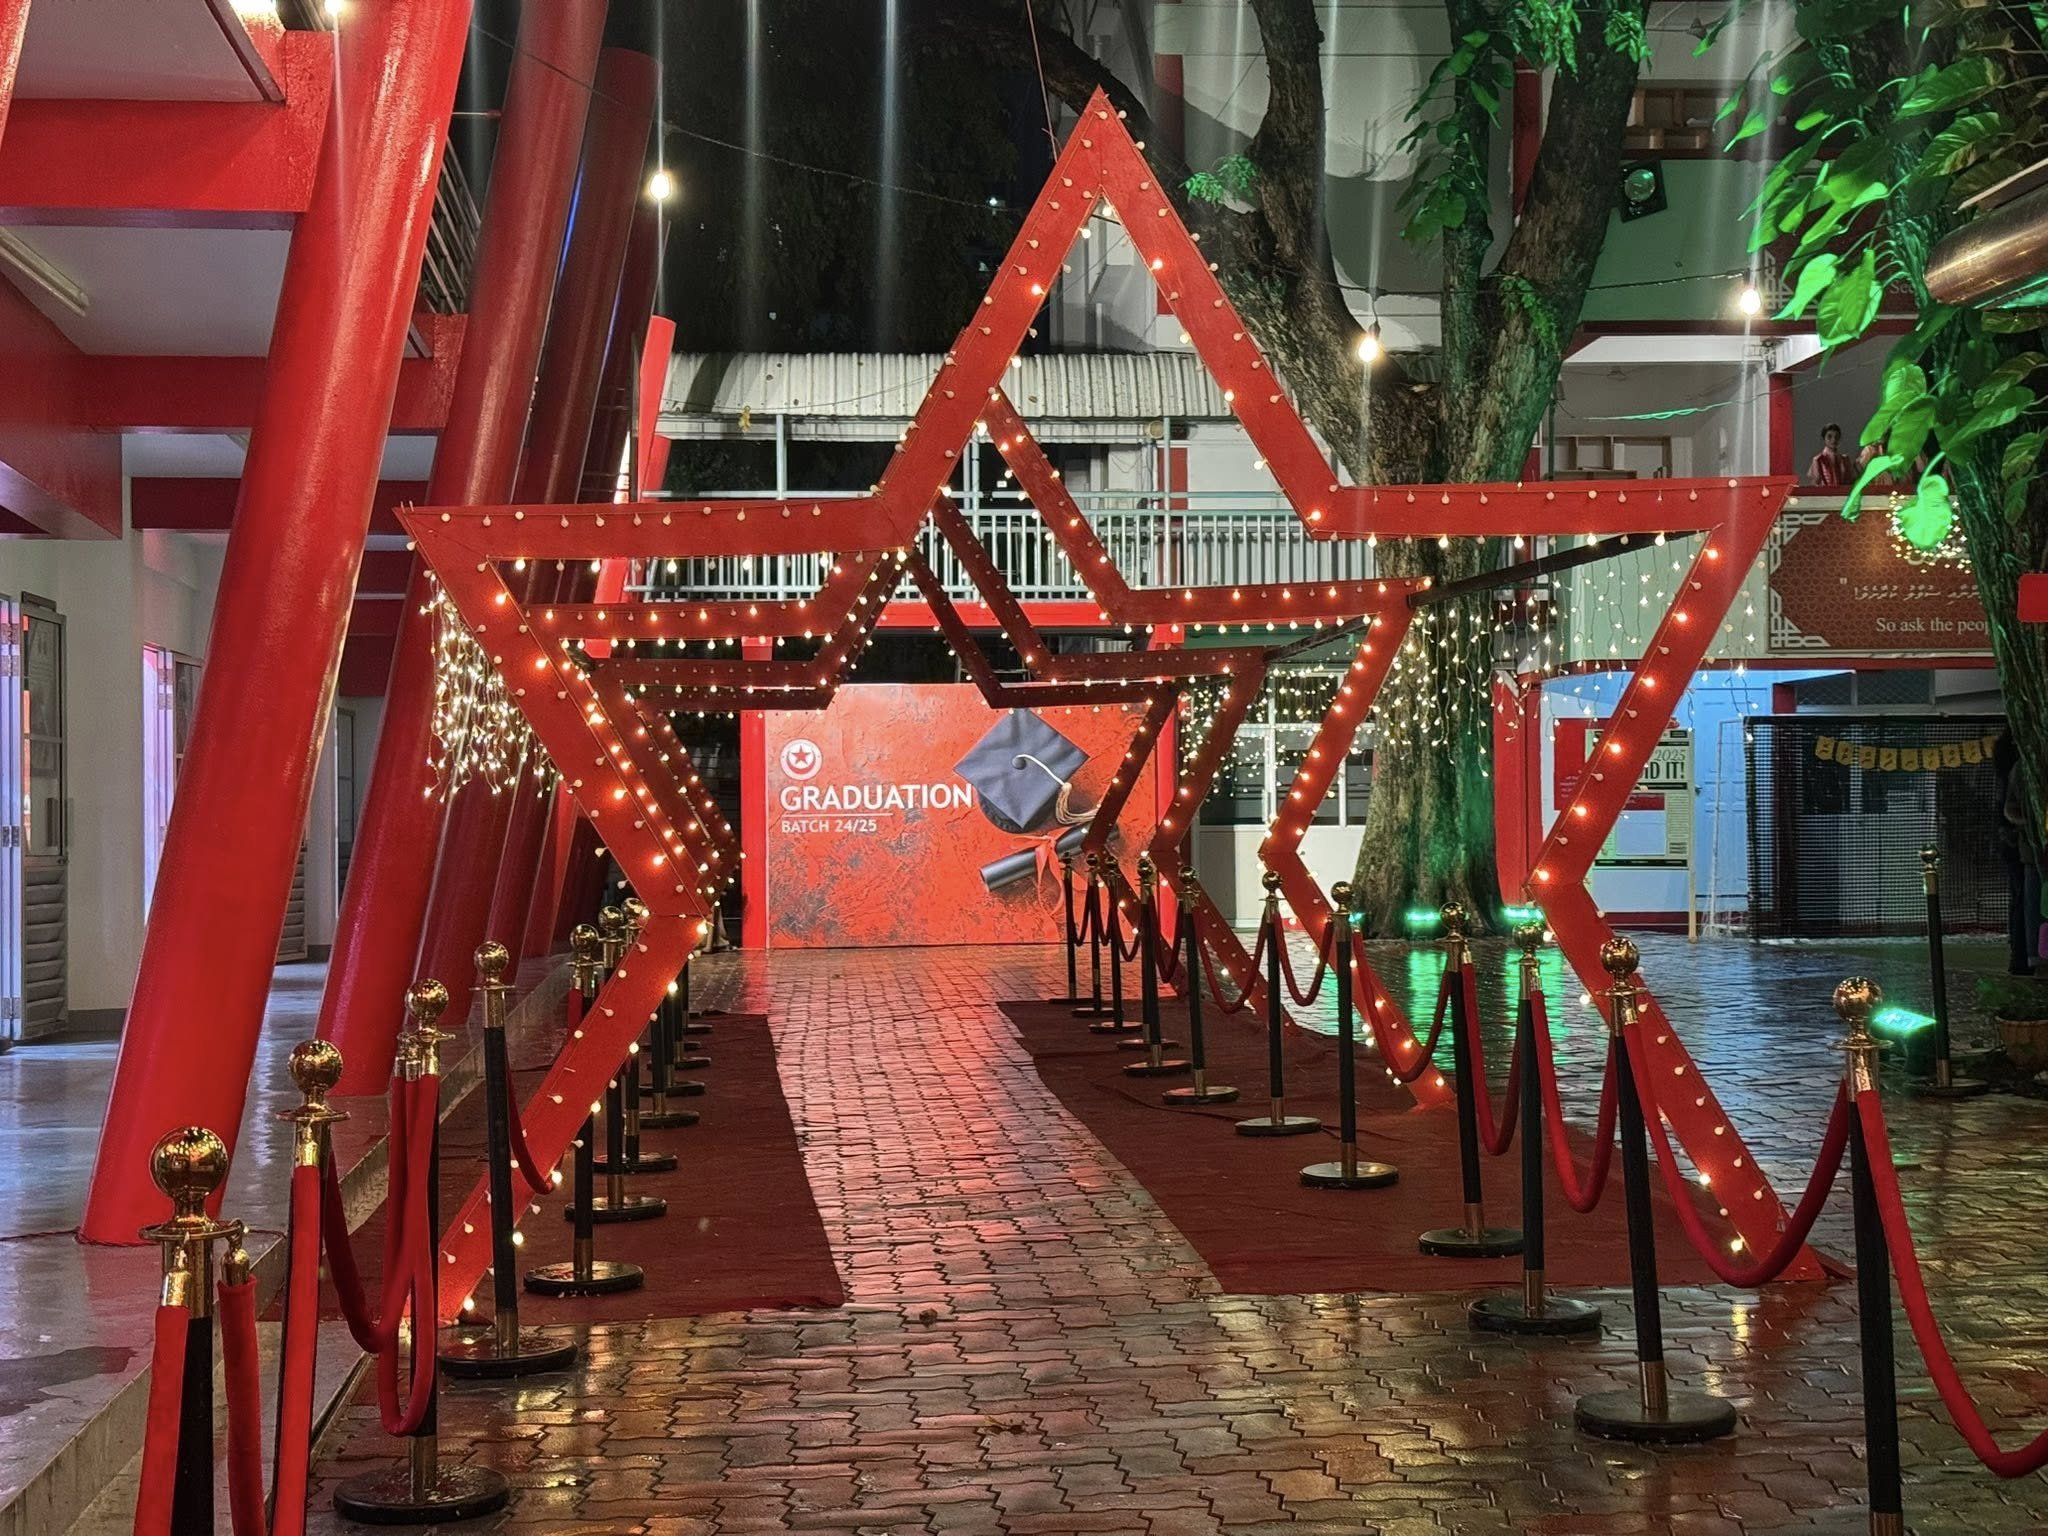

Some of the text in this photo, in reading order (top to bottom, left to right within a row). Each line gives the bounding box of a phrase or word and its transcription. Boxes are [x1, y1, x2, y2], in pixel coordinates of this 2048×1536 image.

[1876, 617, 1898, 632] So
[1900, 617, 1926, 632] ask
[1930, 617, 1953, 632] the
[1653, 749, 1687, 762] 2025
[1640, 761, 1685, 779] ID IT!
[779, 782, 973, 812] GRADUATION
[780, 818, 878, 834] BATCH 24/25
